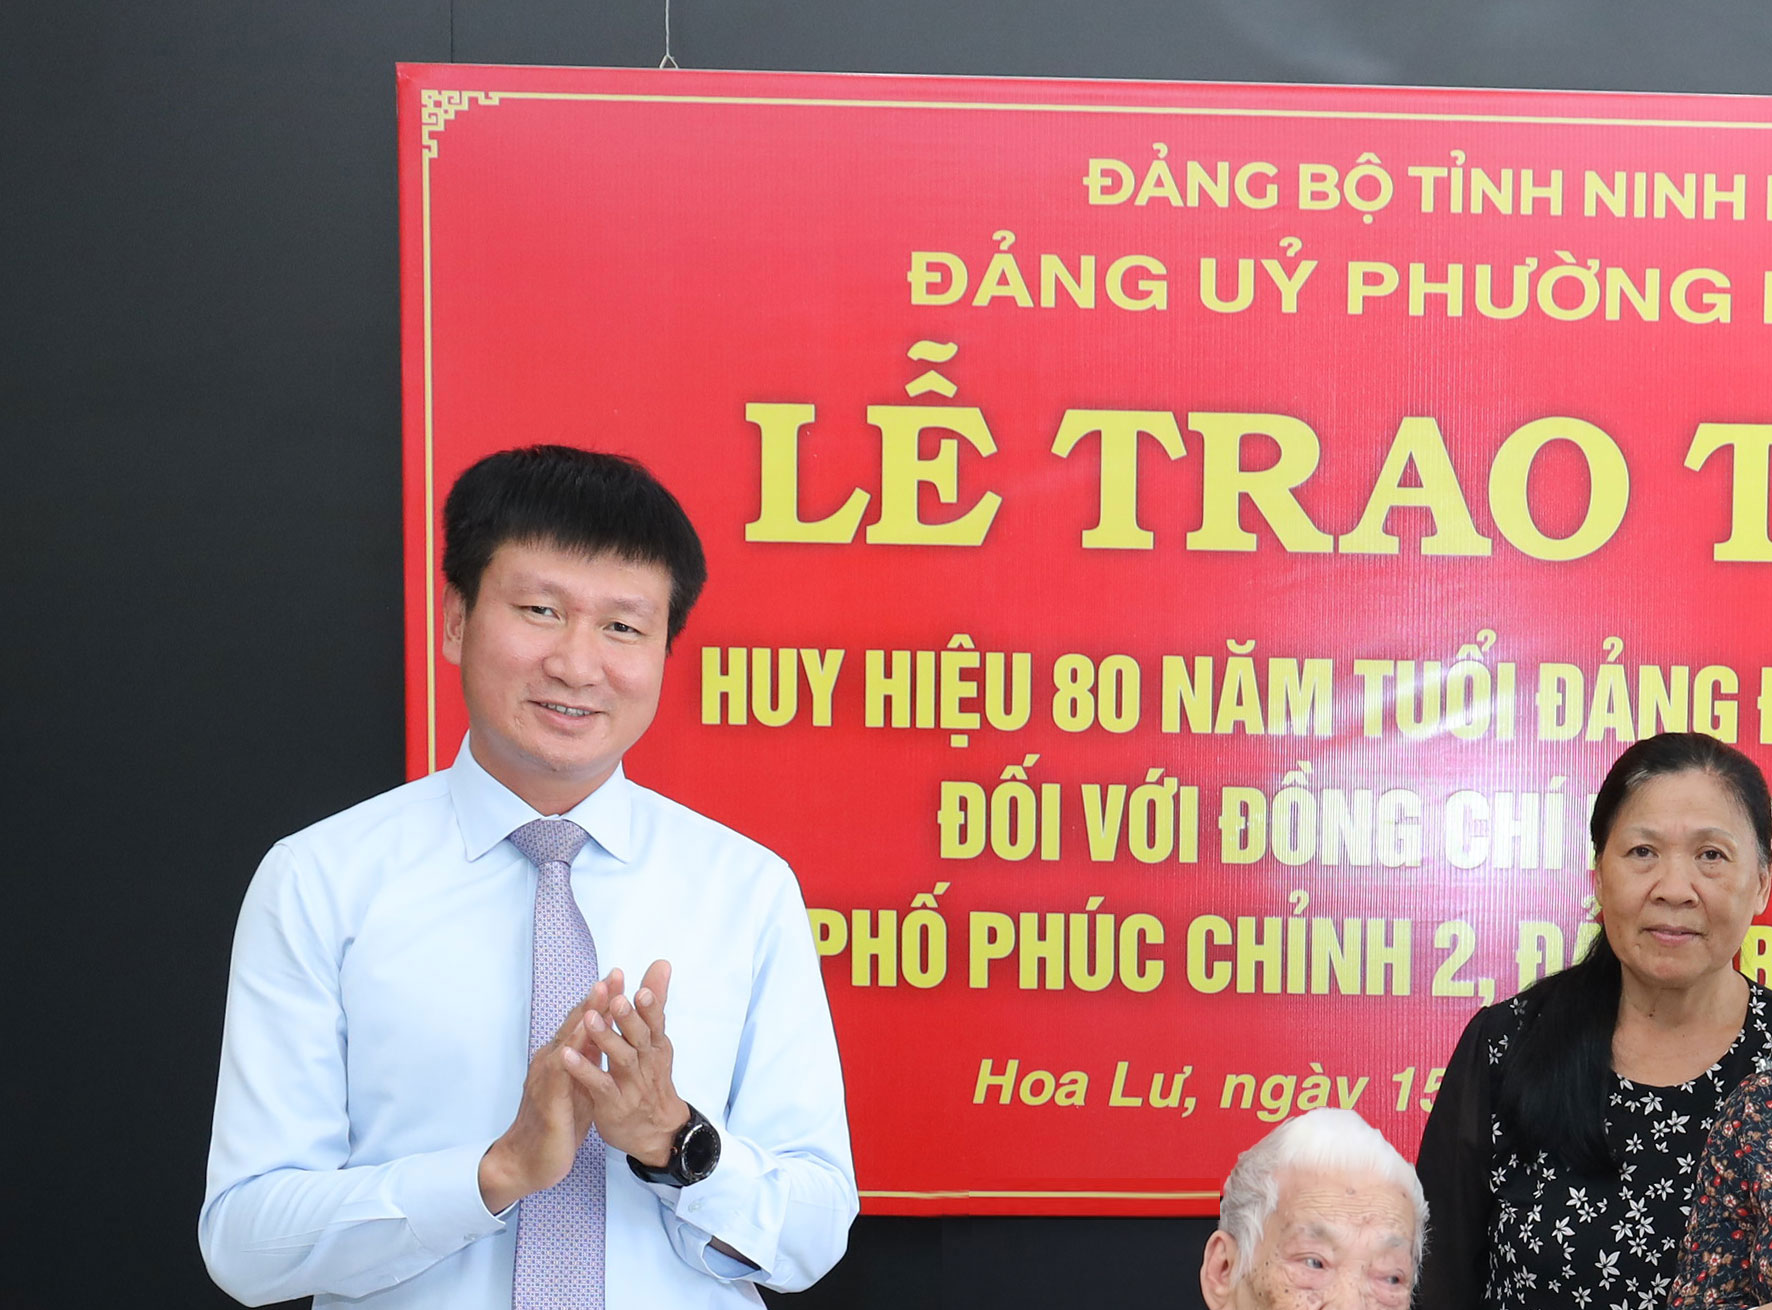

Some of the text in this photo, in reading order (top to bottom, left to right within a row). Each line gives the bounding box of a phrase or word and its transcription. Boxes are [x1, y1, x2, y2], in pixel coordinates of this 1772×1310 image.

[1082, 142, 1279, 209] ĐẢNG
[1298, 151, 1394, 224] BỘ
[1407, 149, 1564, 216] TỈNH
[1583, 170, 1747, 221] NINH
[906, 229, 1169, 311] ĐẢNG
[1198, 236, 1318, 314] UỶ
[1346, 250, 1733, 326] PHƯỜNG
[744, 340, 1002, 547] LỄ
[1050, 409, 1630, 562] TRAO
[700, 646, 846, 728] HUY
[864, 633, 1033, 748] HIỆU
[1052, 653, 1142, 735] 80
[1160, 639, 1334, 738] NĂM
[1353, 628, 1516, 742] TUỔI
[1535, 635, 1740, 745] ĐẢNG
[937, 753, 1061, 862] ĐỐI
[1080, 767, 1200, 865] VỚI
[1218, 761, 1420, 869] ĐỒNG
[1445, 775, 1567, 871] CHÍ
[807, 882, 951, 989] PHỐ
[968, 896, 1166, 995] PHÚC
[1186, 889, 1412, 998] CHỈNH
[1431, 921, 1497, 1007] 2,
[972, 1058, 1089, 1107] Hoa
[1108, 1061, 1198, 1119] Lư,
[1219, 1062, 1370, 1124] ngày
